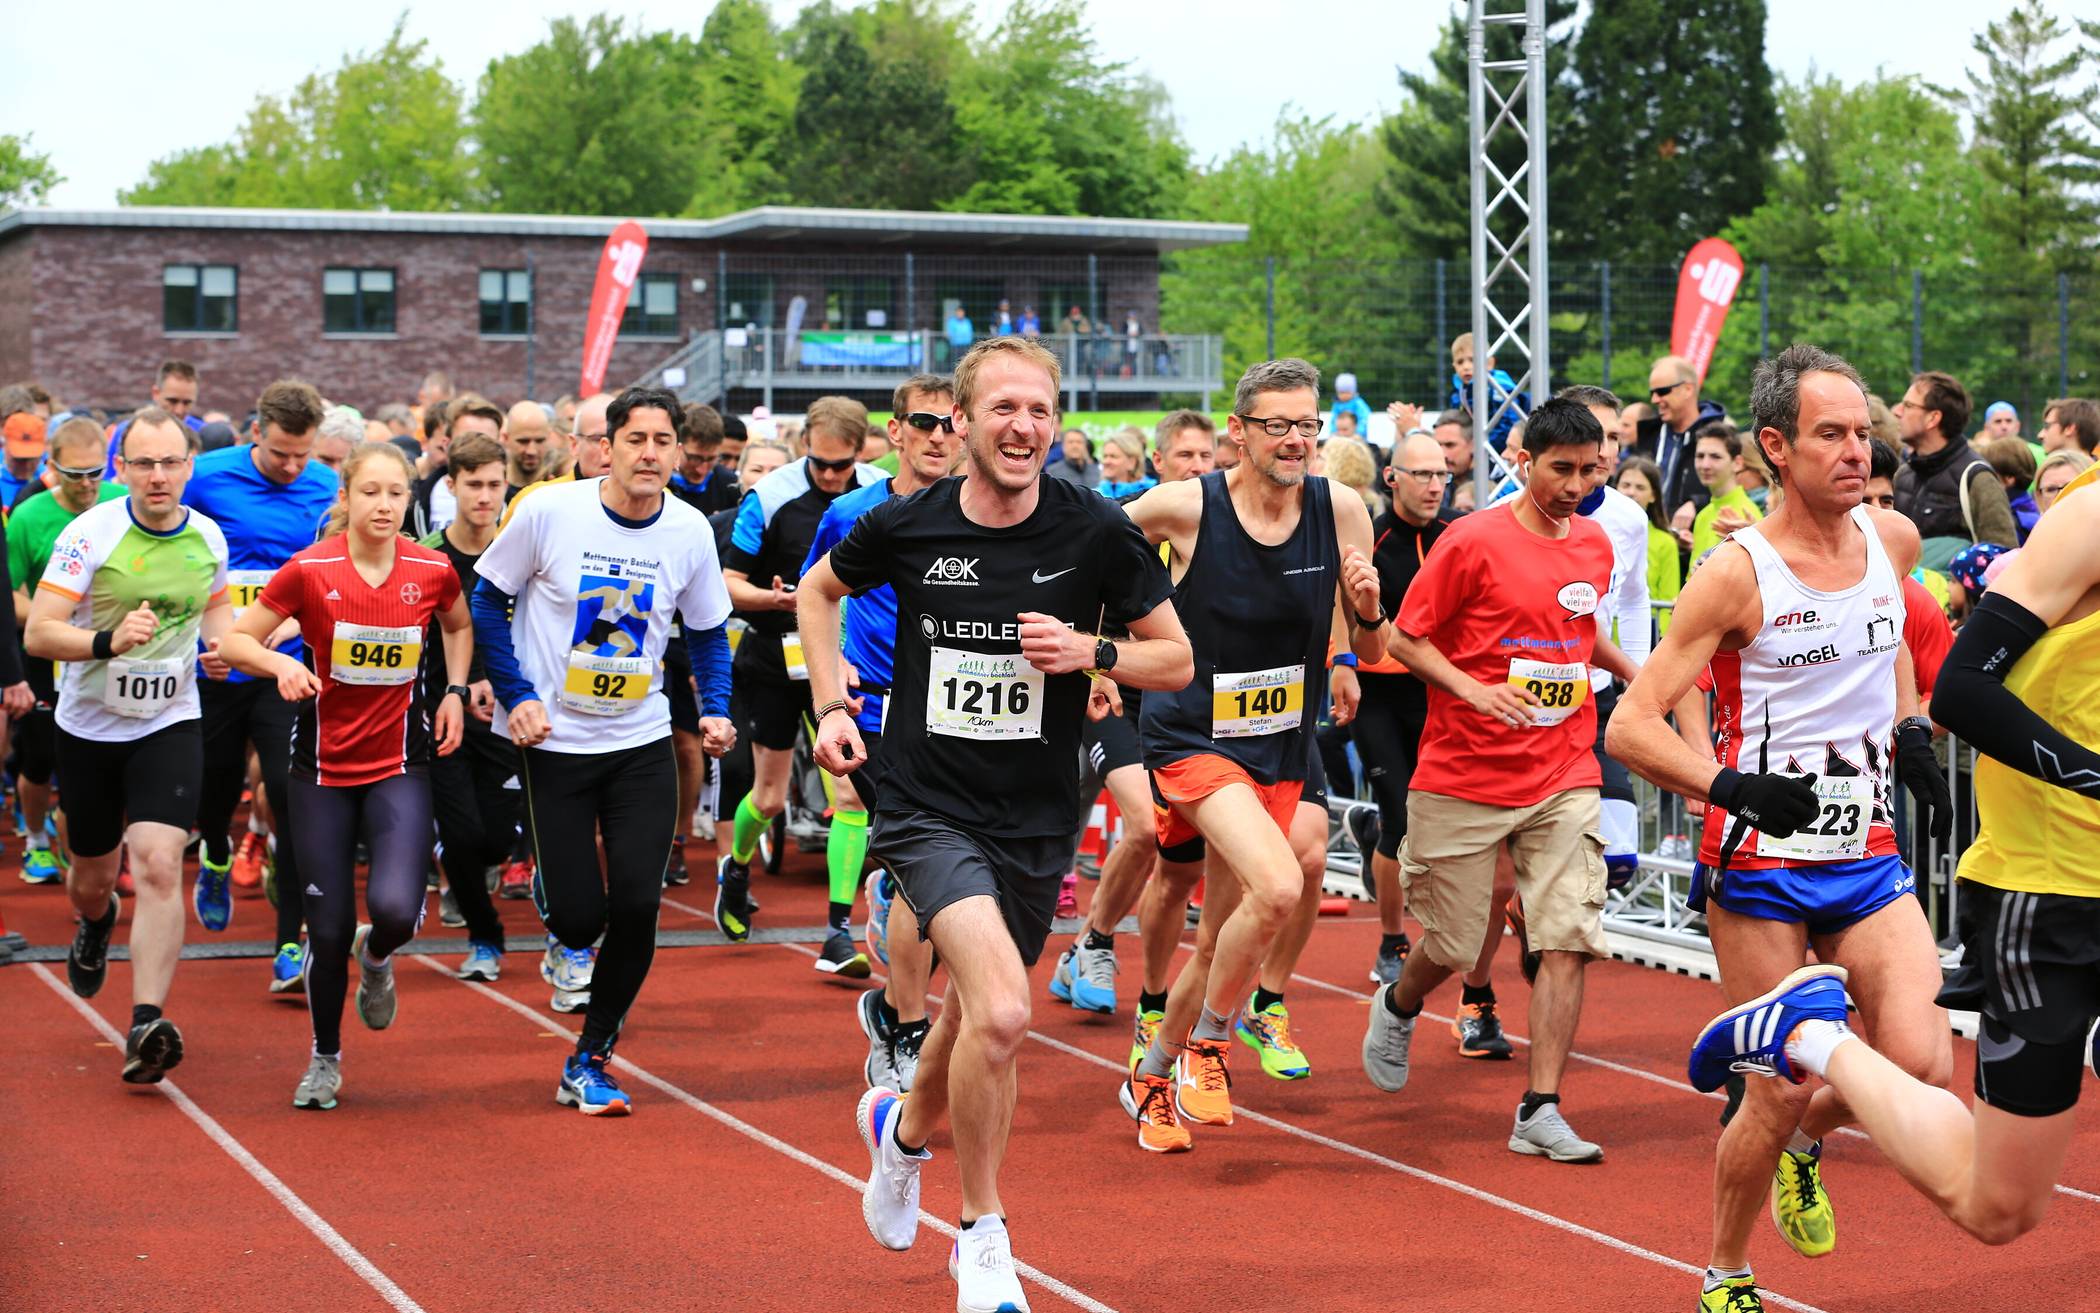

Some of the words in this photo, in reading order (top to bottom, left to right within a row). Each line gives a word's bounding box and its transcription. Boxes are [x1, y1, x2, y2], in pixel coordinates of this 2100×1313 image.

[583, 552, 628, 565] Mettmanner
[924, 557, 980, 580] AOK
[1566, 597, 1581, 607] viel
[1793, 624, 1825, 633] verstehen
[350, 642, 403, 668] 946
[1777, 644, 1840, 666] VOGEL
[1857, 647, 1879, 657] TEAM
[116, 675, 177, 700] 1010
[592, 673, 627, 698] 92
[943, 677, 1030, 715] 1216
[1234, 687, 1287, 718] 140
[1249, 718, 1272, 726] Stefan
